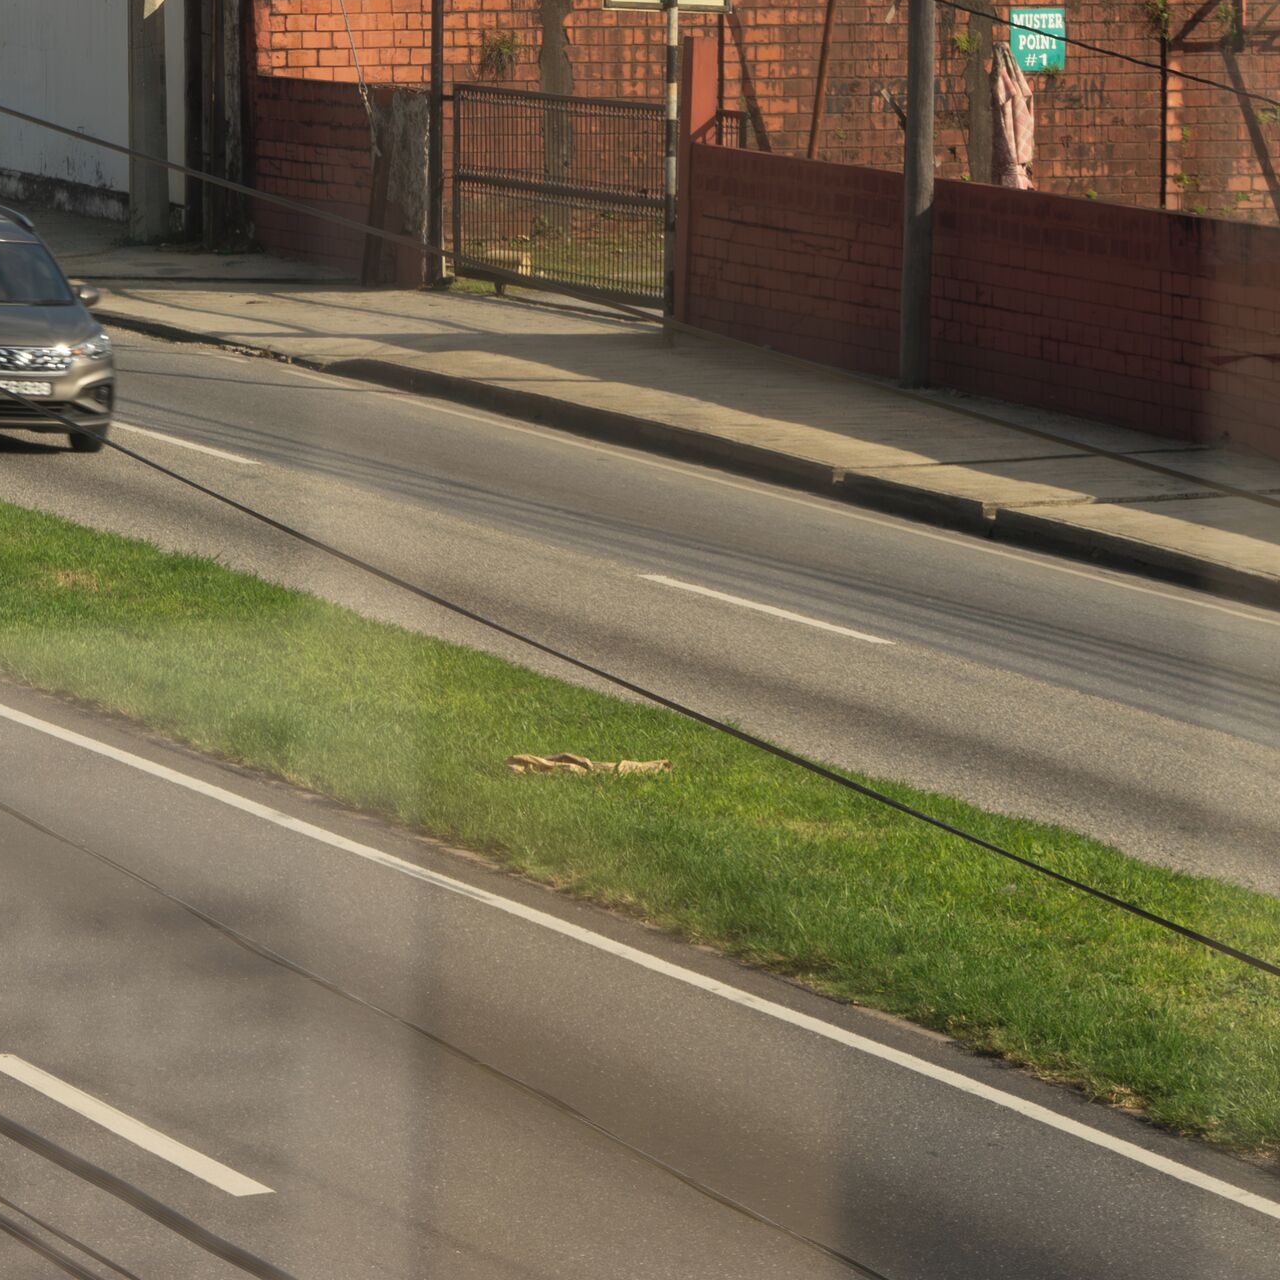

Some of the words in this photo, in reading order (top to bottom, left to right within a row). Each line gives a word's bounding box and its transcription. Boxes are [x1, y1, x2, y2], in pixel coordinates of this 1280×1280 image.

[1012, 13, 1063, 30] MUSTER
[1018, 33, 1059, 51] POINT
[1024, 52, 1048, 68] #1
